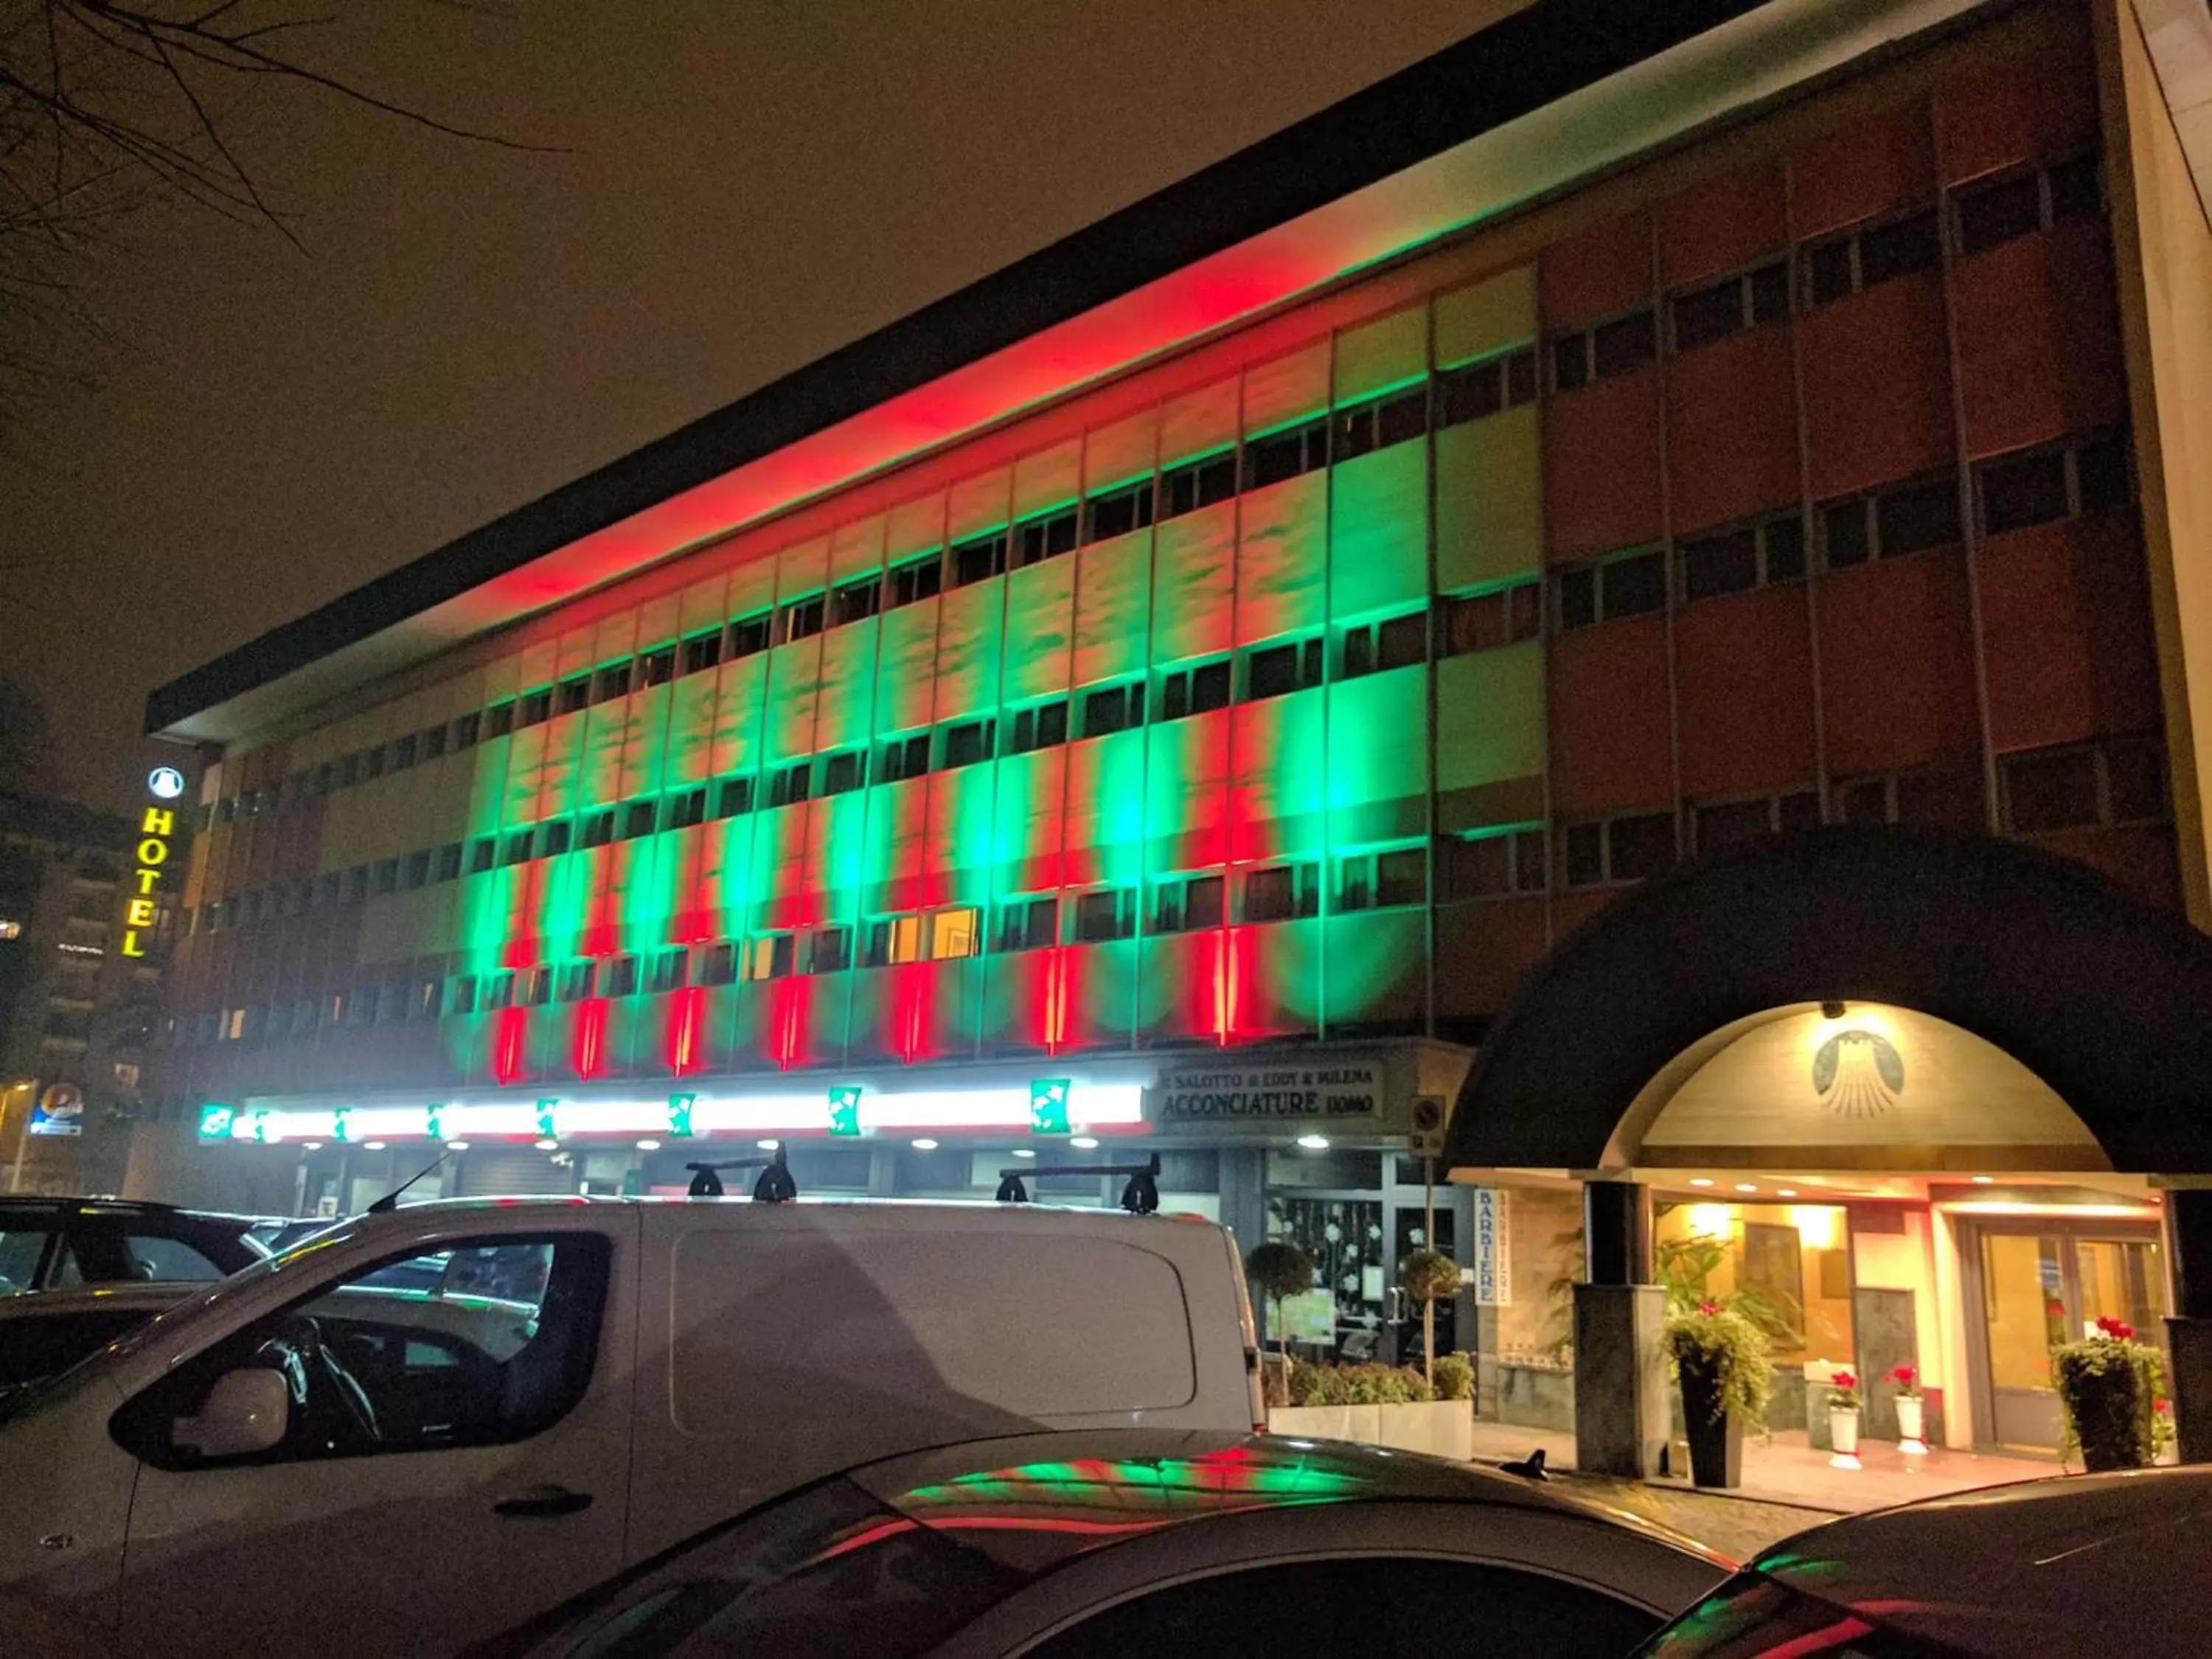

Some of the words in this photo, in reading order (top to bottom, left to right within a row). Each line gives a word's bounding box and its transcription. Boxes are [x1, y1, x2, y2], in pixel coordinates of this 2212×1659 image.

[121, 806, 174, 958] HOTEL
[1162, 1091, 1319, 1116] ACCONCIATURE
[1175, 1074, 1242, 1089] SALOTTO
[1263, 1071, 1298, 1087] EDDY
[1301, 1071, 1312, 1085] &
[1480, 1192, 1492, 1301] BARBIERE
